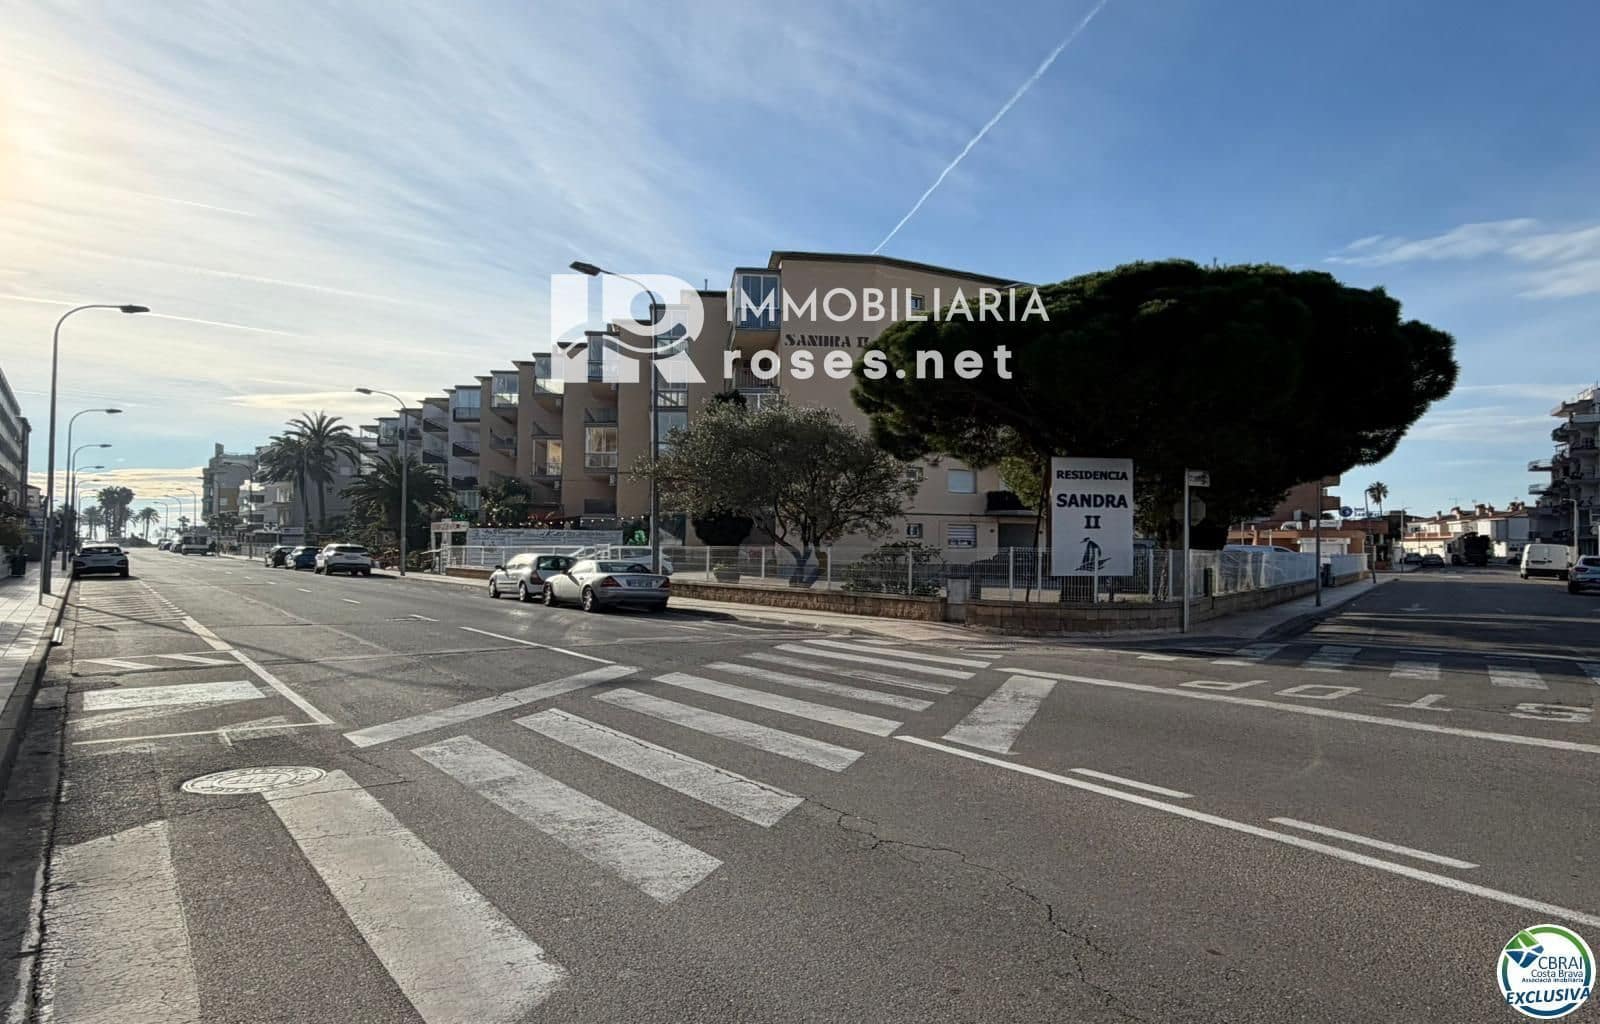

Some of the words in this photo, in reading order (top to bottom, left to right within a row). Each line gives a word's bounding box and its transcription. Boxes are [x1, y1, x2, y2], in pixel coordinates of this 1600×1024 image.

[785, 334, 851, 348] SANDRA
[1056, 470, 1128, 481] RESIDENCIA
[1056, 493, 1128, 509] SANDRA
[1084, 515, 1101, 529] II
